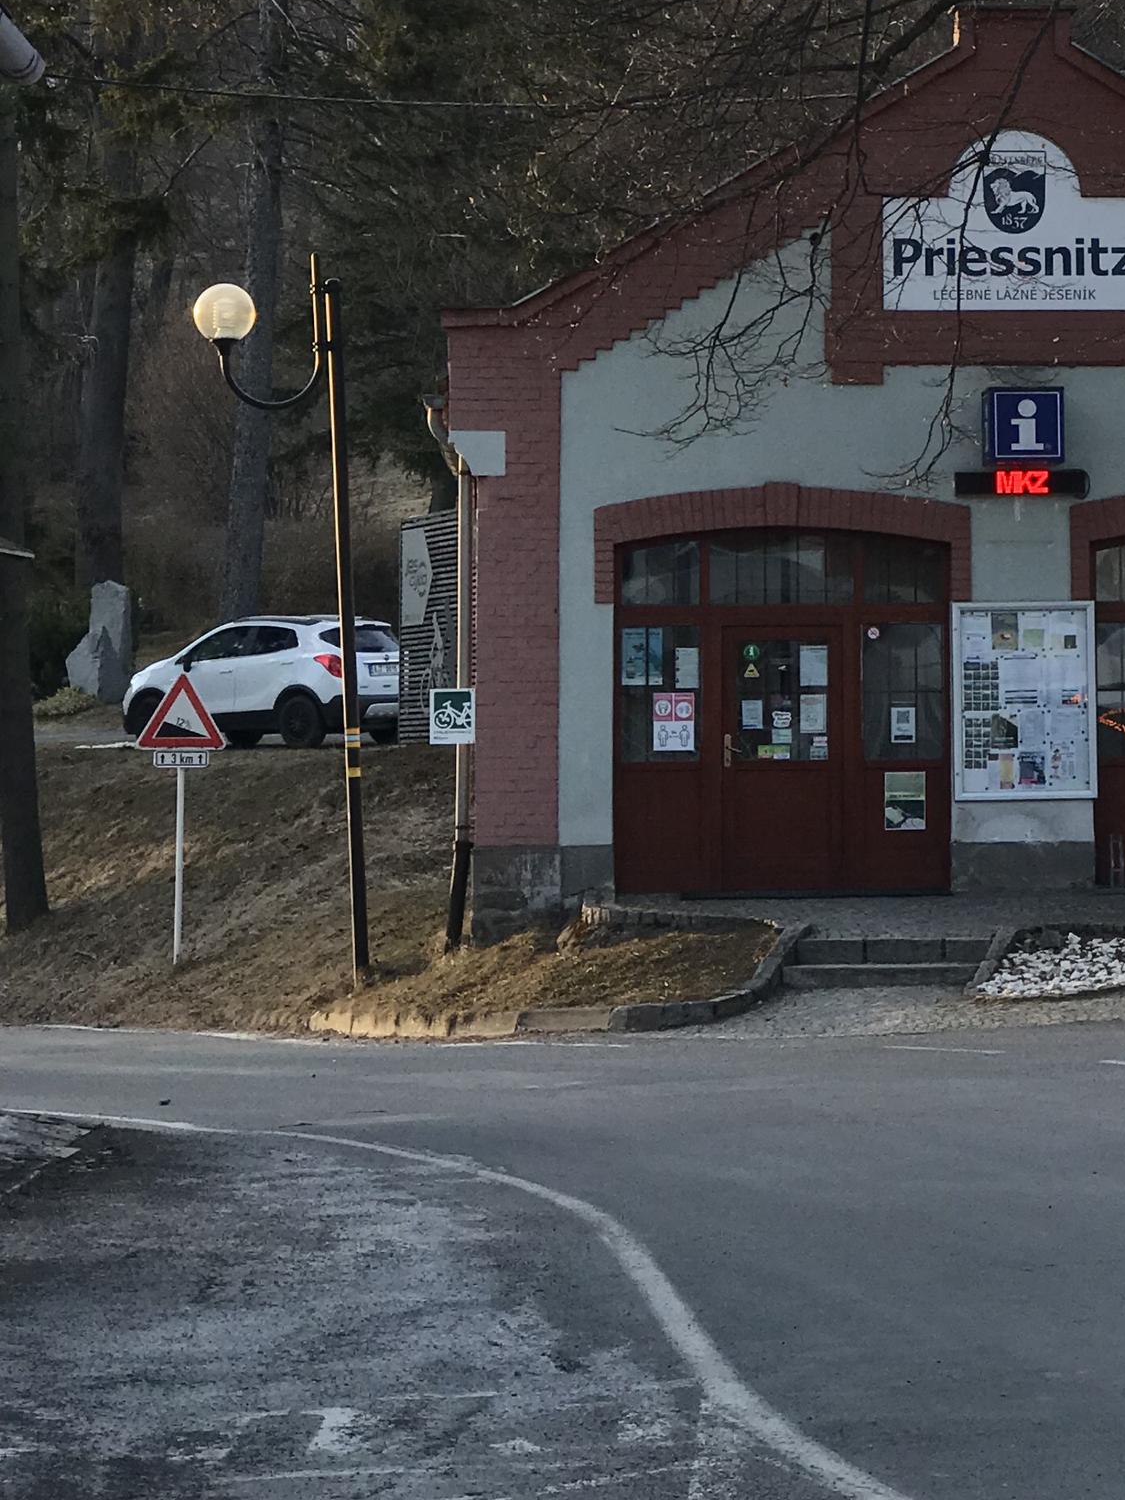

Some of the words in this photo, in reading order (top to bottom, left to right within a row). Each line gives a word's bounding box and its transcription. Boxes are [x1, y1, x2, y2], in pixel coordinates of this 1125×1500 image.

[932, 286, 992, 301] LÉČEBNÉ
[996, 286, 1037, 301] LÁZNĚ
[1041, 286, 1097, 301] JESENÍK
[171, 753, 176, 764] 3
[180, 753, 194, 764] km
